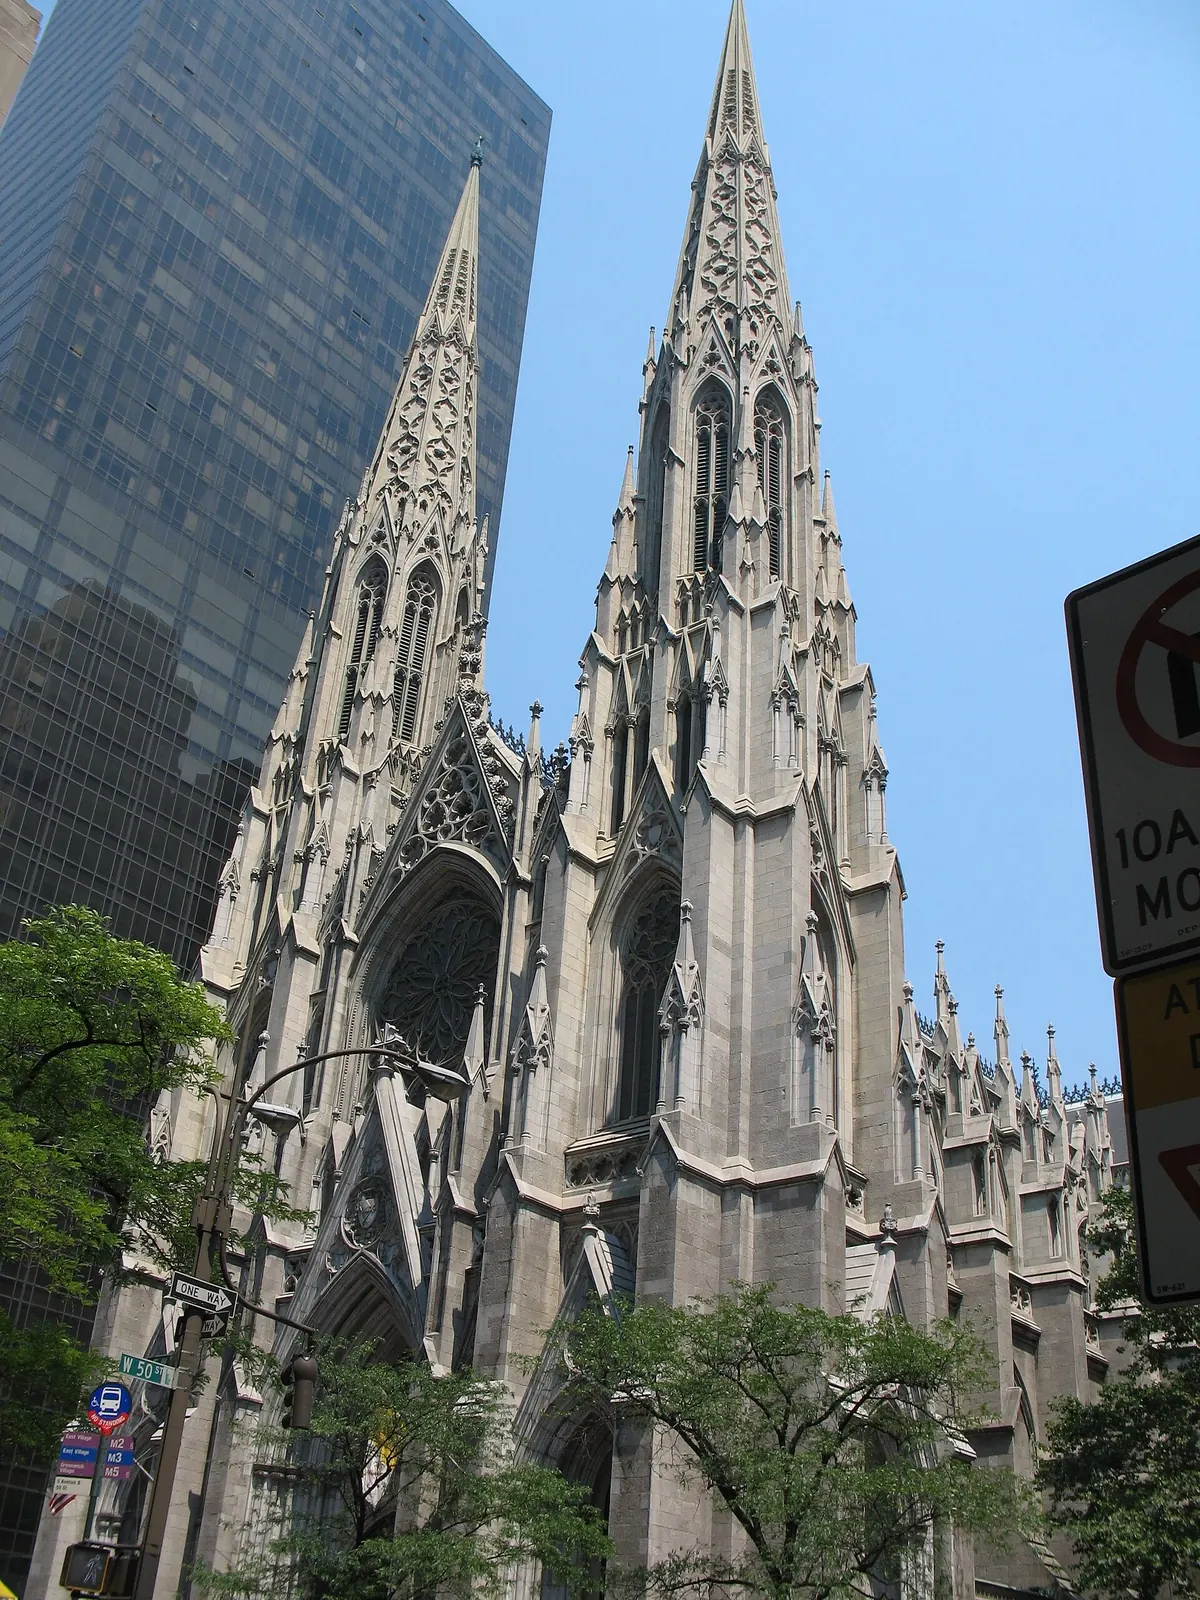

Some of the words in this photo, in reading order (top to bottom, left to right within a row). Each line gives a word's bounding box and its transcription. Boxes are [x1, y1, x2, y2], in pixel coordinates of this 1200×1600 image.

[1156, 1282, 1185, 1294] SW-621
[180, 1283, 200, 1298] ONE
[206, 1292, 227, 1307] WAY
[204, 1320, 220, 1331] WAY
[123, 1356, 133, 1373] W
[136, 1361, 153, 1379] 50
[155, 1366, 164, 1375] ST
[90, 1413, 98, 1422] NO
[99, 1415, 126, 1426] STANDING
[110, 1438, 125, 1449] M2
[107, 1452, 122, 1463] M3
[105, 1467, 119, 1477] M5
